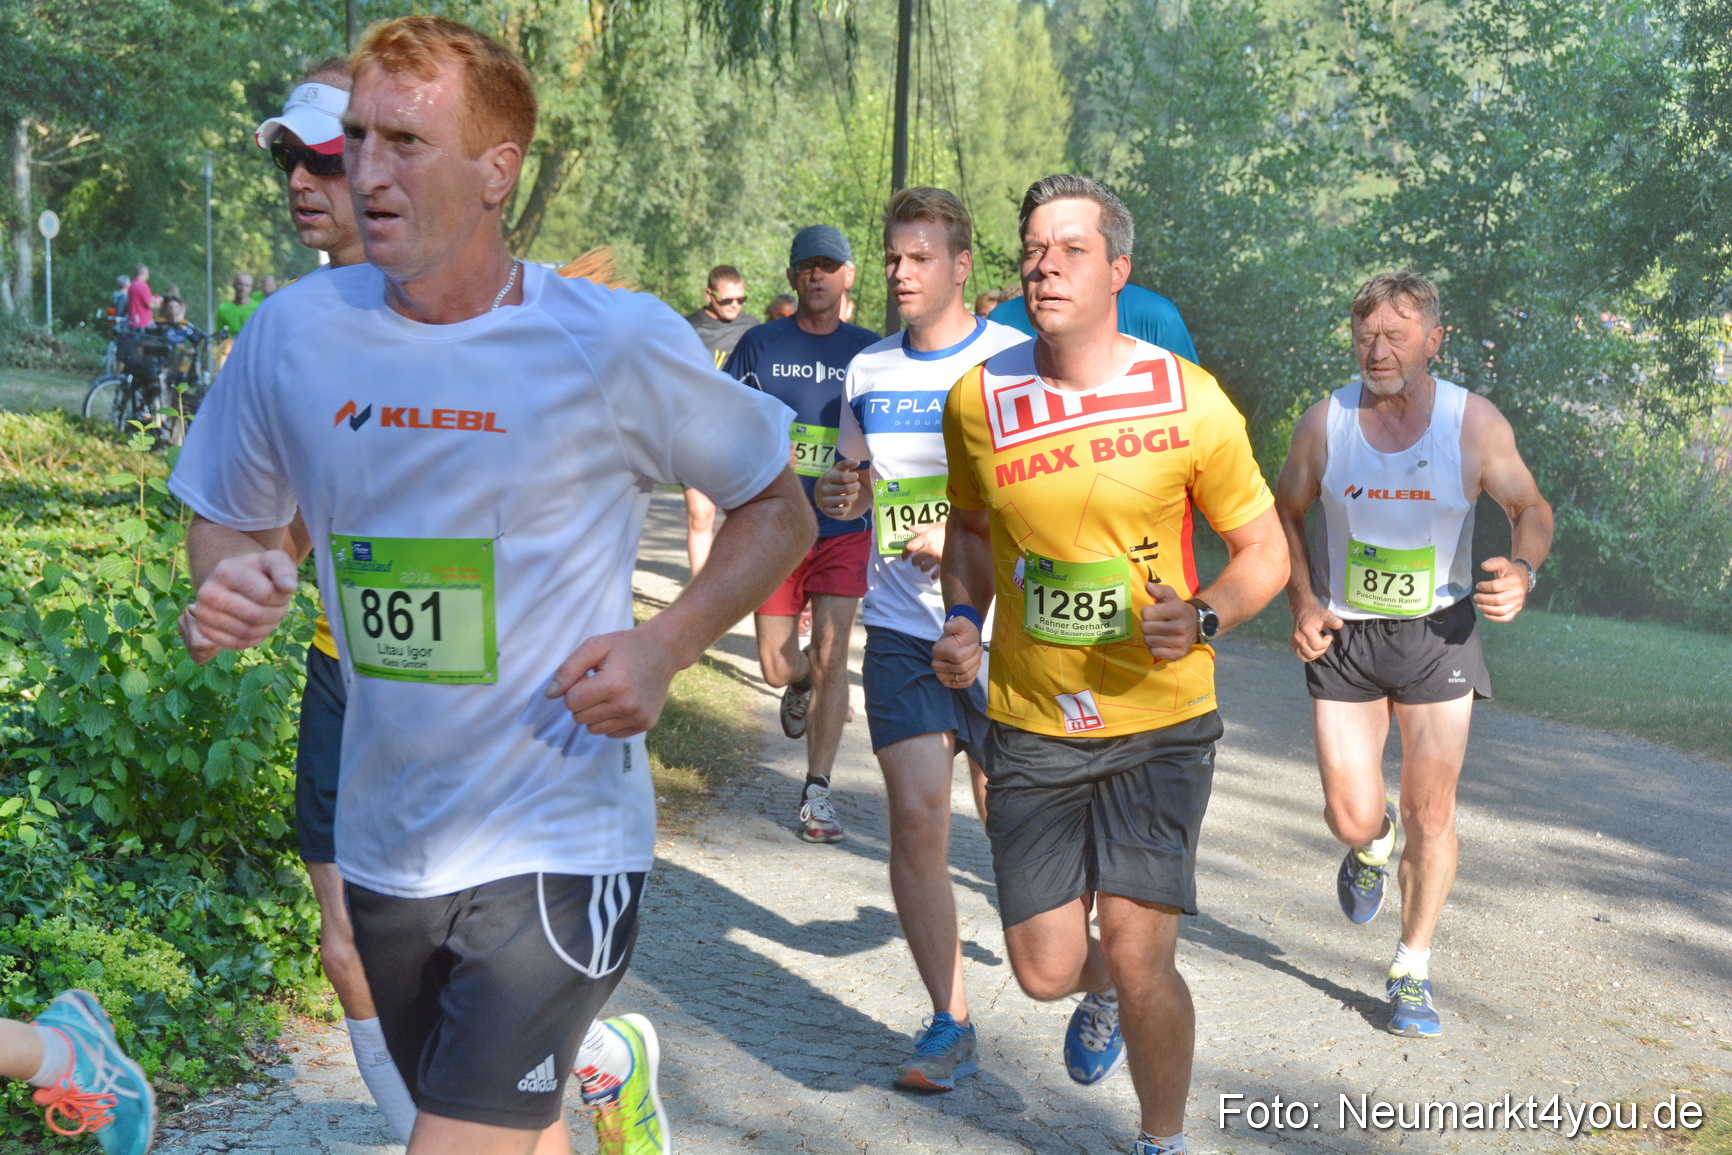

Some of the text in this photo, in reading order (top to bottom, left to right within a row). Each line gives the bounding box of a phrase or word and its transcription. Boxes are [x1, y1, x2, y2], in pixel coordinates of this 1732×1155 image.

[772, 363, 814, 379] EURO
[869, 397, 942, 414] TR PLA
[380, 407, 507, 433] KLEBL
[795, 442, 834, 463] 517
[995, 426, 1190, 488] MAX BÖGL
[1367, 488, 1437, 501] KLEBL
[885, 502, 950, 532] 1948
[400, 572, 432, 583] 2018
[1072, 581, 1095, 589] 2018
[1362, 568, 1415, 597] 873
[1033, 585, 1118, 621] 1285
[1356, 590, 1397, 603] Puschmann
[361, 589, 442, 641] 861
[1039, 617, 1110, 631] Rehner Gerhard
[377, 643, 433, 660] Litau Igor
[517, 1078, 558, 1093] adidas
